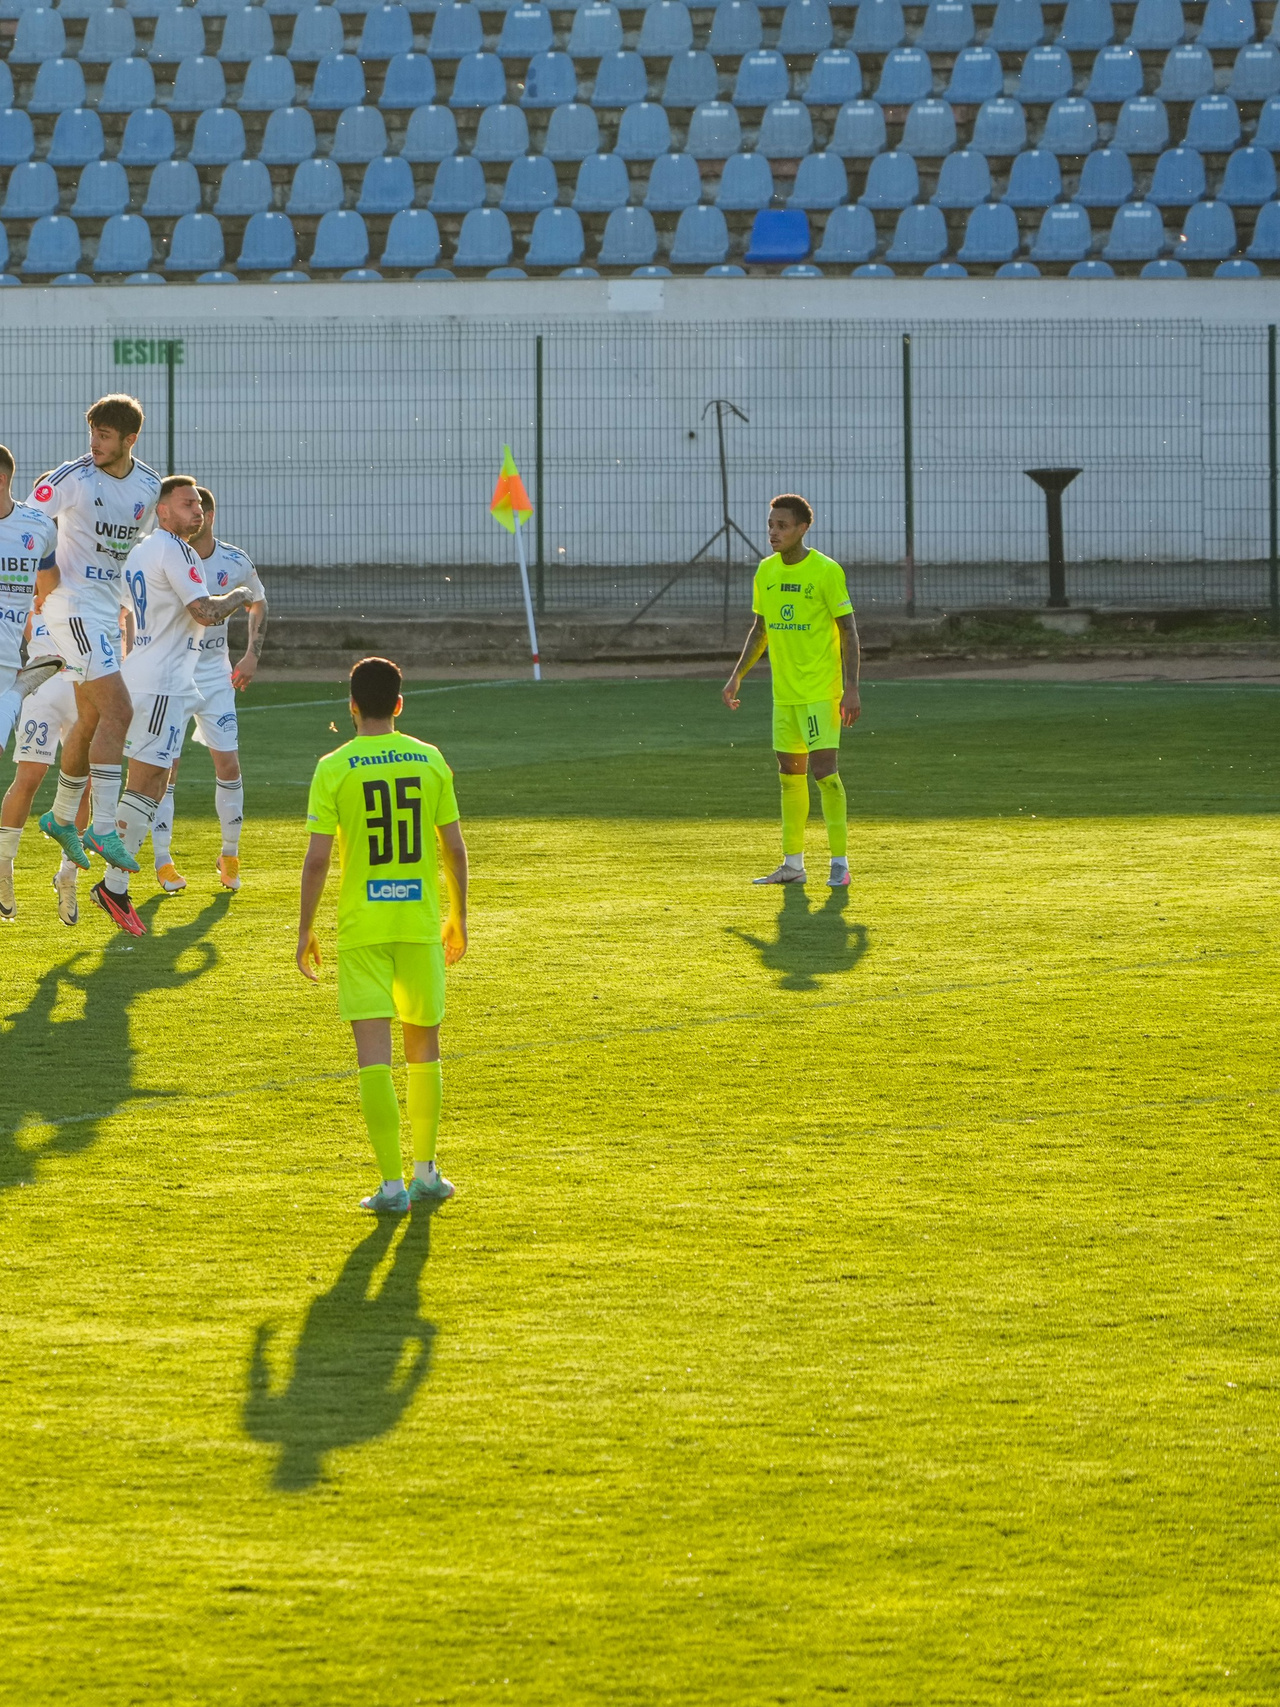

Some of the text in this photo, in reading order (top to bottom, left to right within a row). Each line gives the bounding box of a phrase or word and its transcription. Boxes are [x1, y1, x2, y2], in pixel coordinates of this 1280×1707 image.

[100, 634, 114, 657] 6
[24, 719, 49, 746] 93
[807, 714, 820, 738] 21
[348, 750, 428, 769] Panifcom
[362, 776, 423, 866] 35
